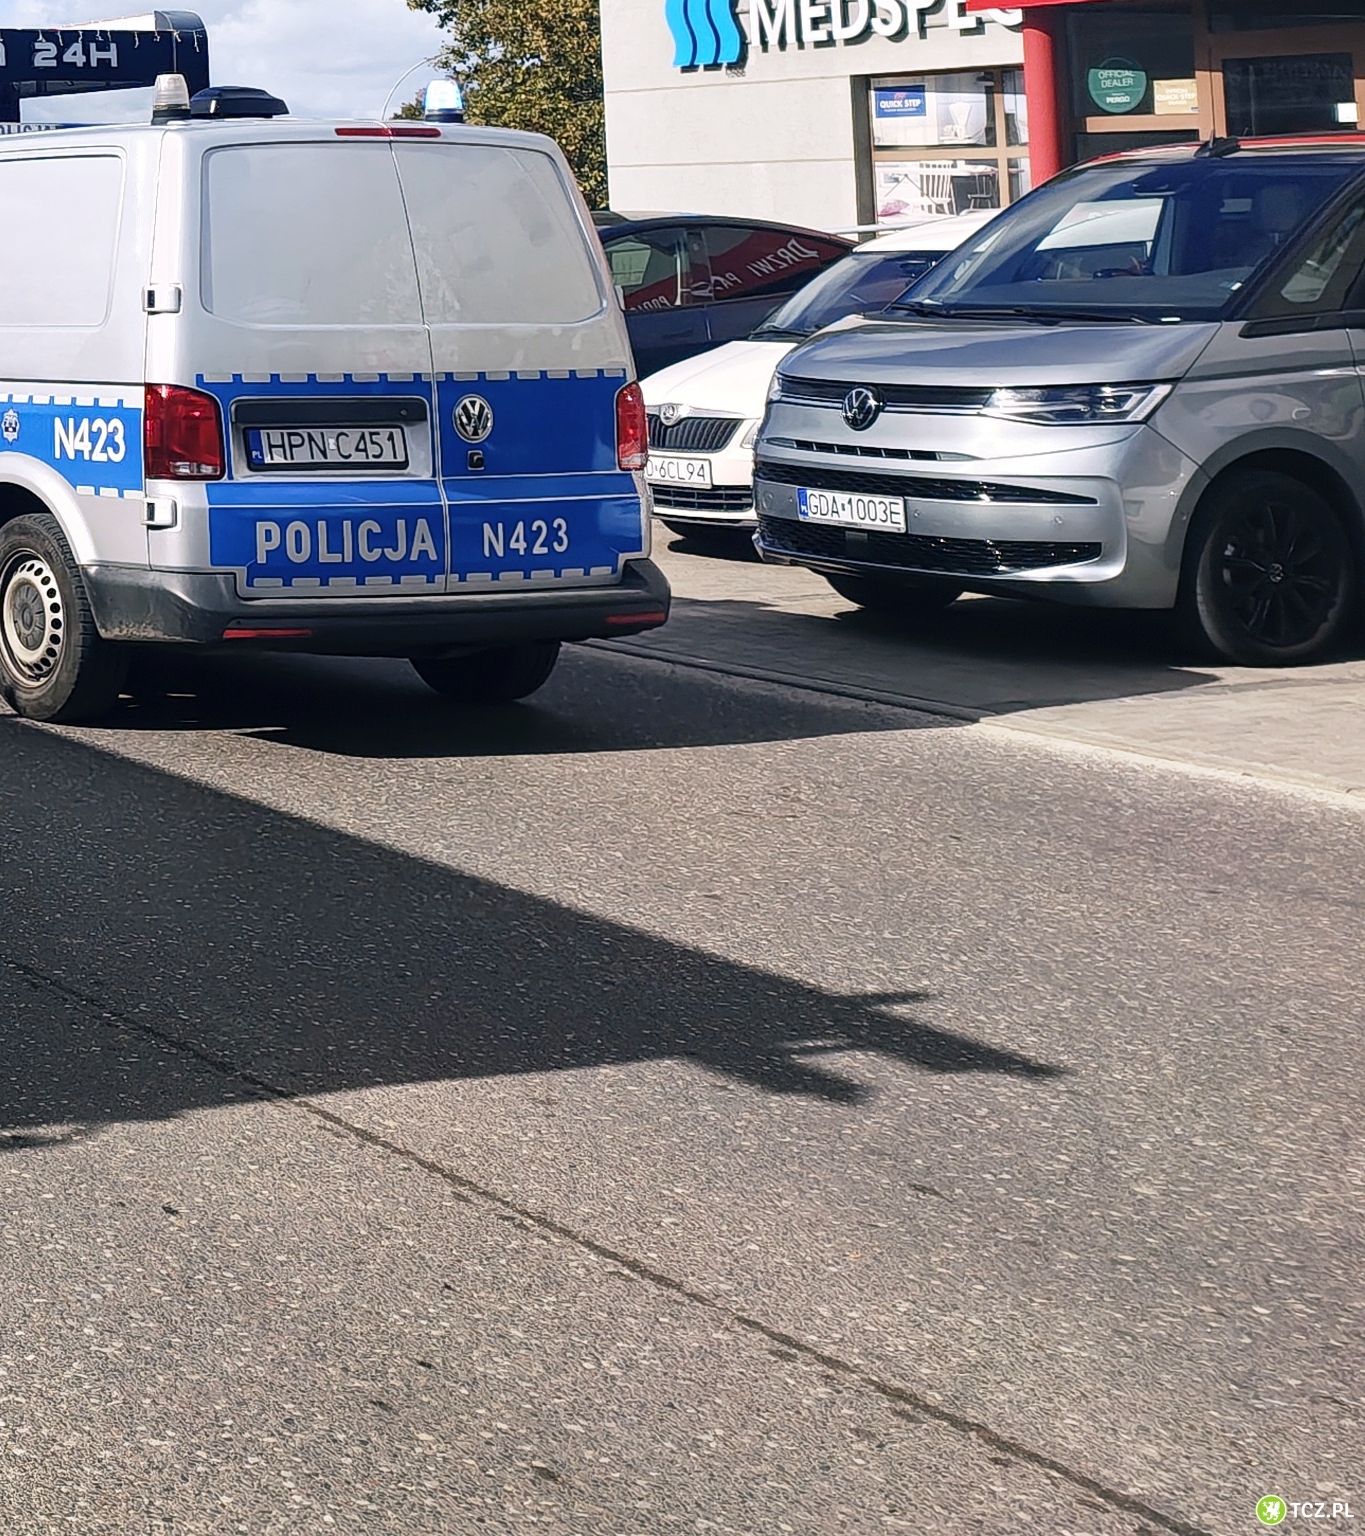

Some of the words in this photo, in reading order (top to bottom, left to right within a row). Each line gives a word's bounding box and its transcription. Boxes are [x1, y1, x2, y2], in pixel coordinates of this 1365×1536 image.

[33, 42, 118, 68] 24H
[1098, 69, 1135, 79] OFFICIAL
[1101, 78, 1134, 88] DEALER
[880, 99, 903, 109] QUICK
[54, 416, 126, 462] N423
[251, 450, 263, 460] PL
[266, 431, 329, 461] HPN
[335, 430, 399, 460] C451
[658, 459, 706, 482] 6CL94
[809, 493, 841, 518] GDA
[846, 493, 902, 526] 1003E
[255, 518, 438, 564] POLICJA
[482, 517, 569, 558] N423
